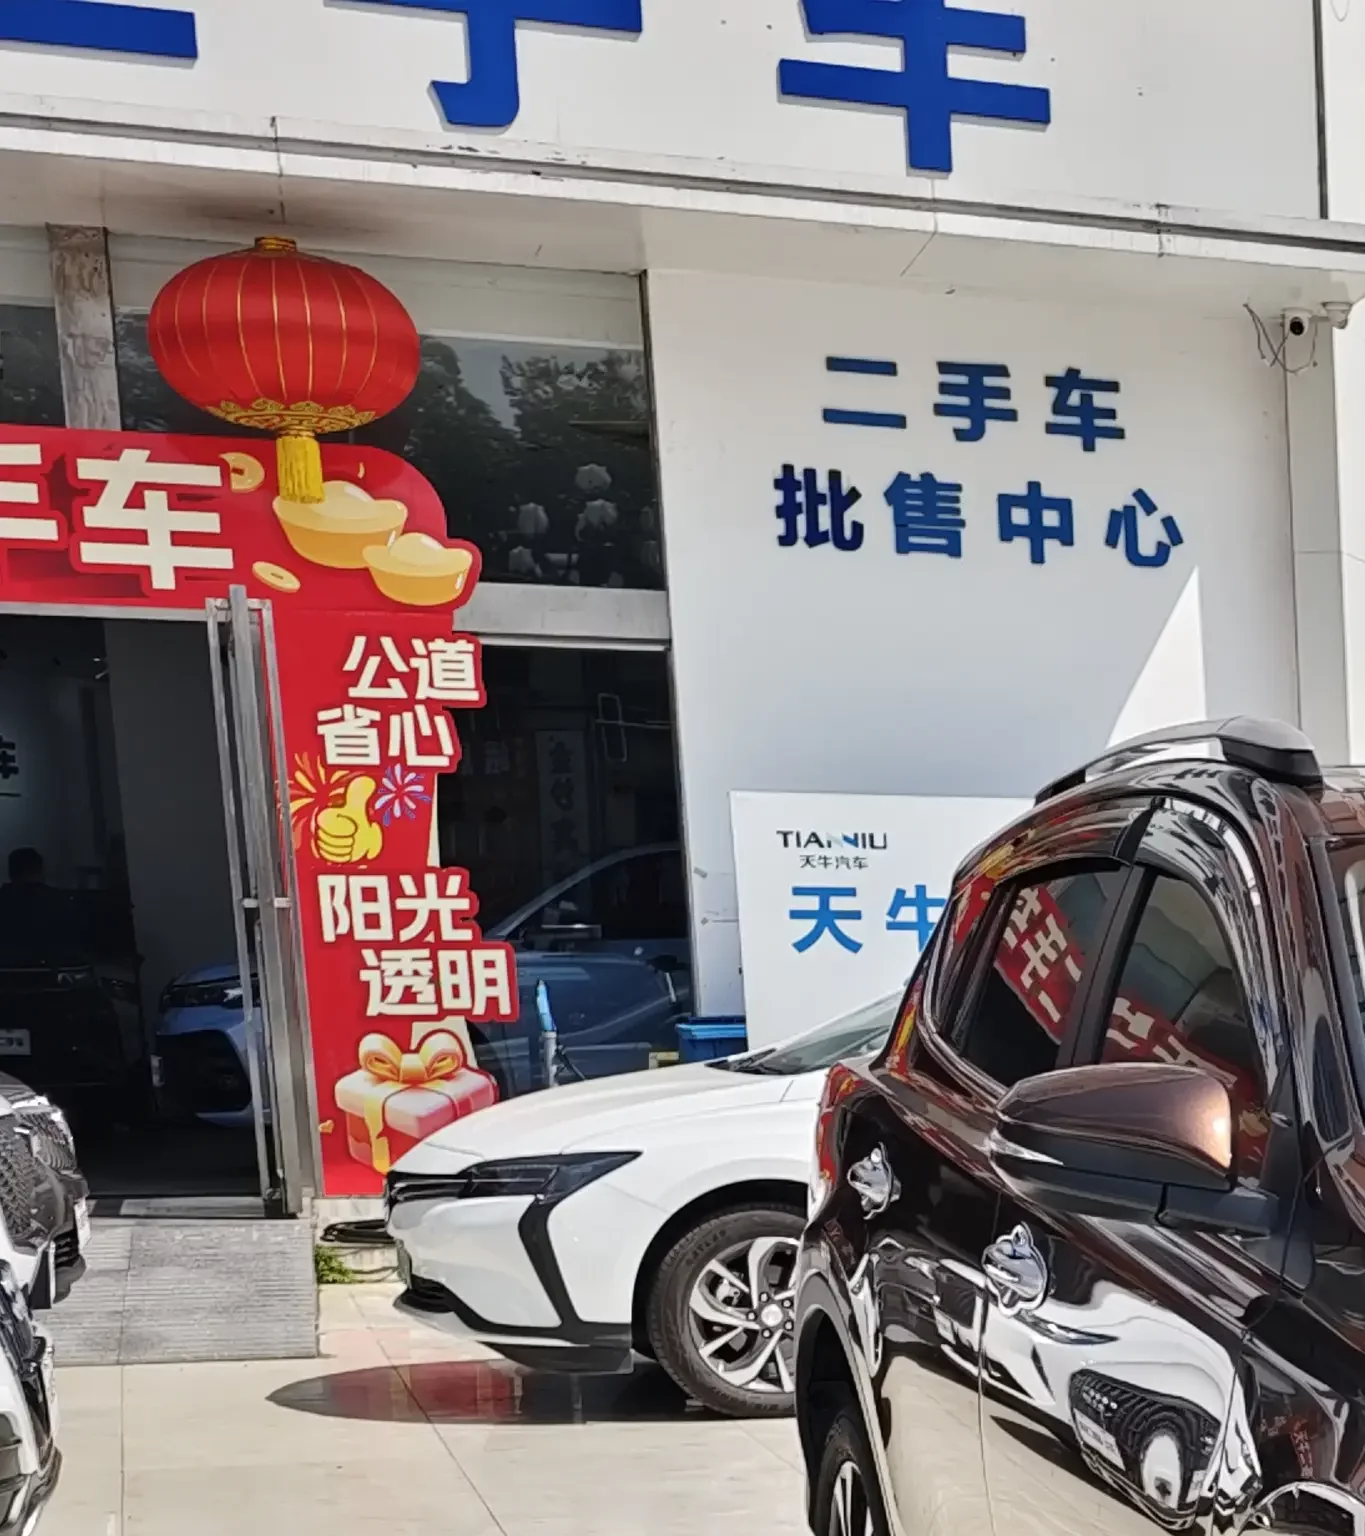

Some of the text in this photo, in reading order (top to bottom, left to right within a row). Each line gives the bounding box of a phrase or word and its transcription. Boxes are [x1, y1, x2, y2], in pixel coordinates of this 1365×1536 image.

[823, 356, 1125, 451] 二手车
[773, 464, 1184, 568] 批售中心
[343, 635, 481, 701] 公道
[316, 705, 455, 767] 省心
[800, 855, 868, 869] 天牛汽车
[317, 874, 473, 942] 阳光
[789, 884, 948, 954] 天牛
[360, 948, 511, 1016] 透明
